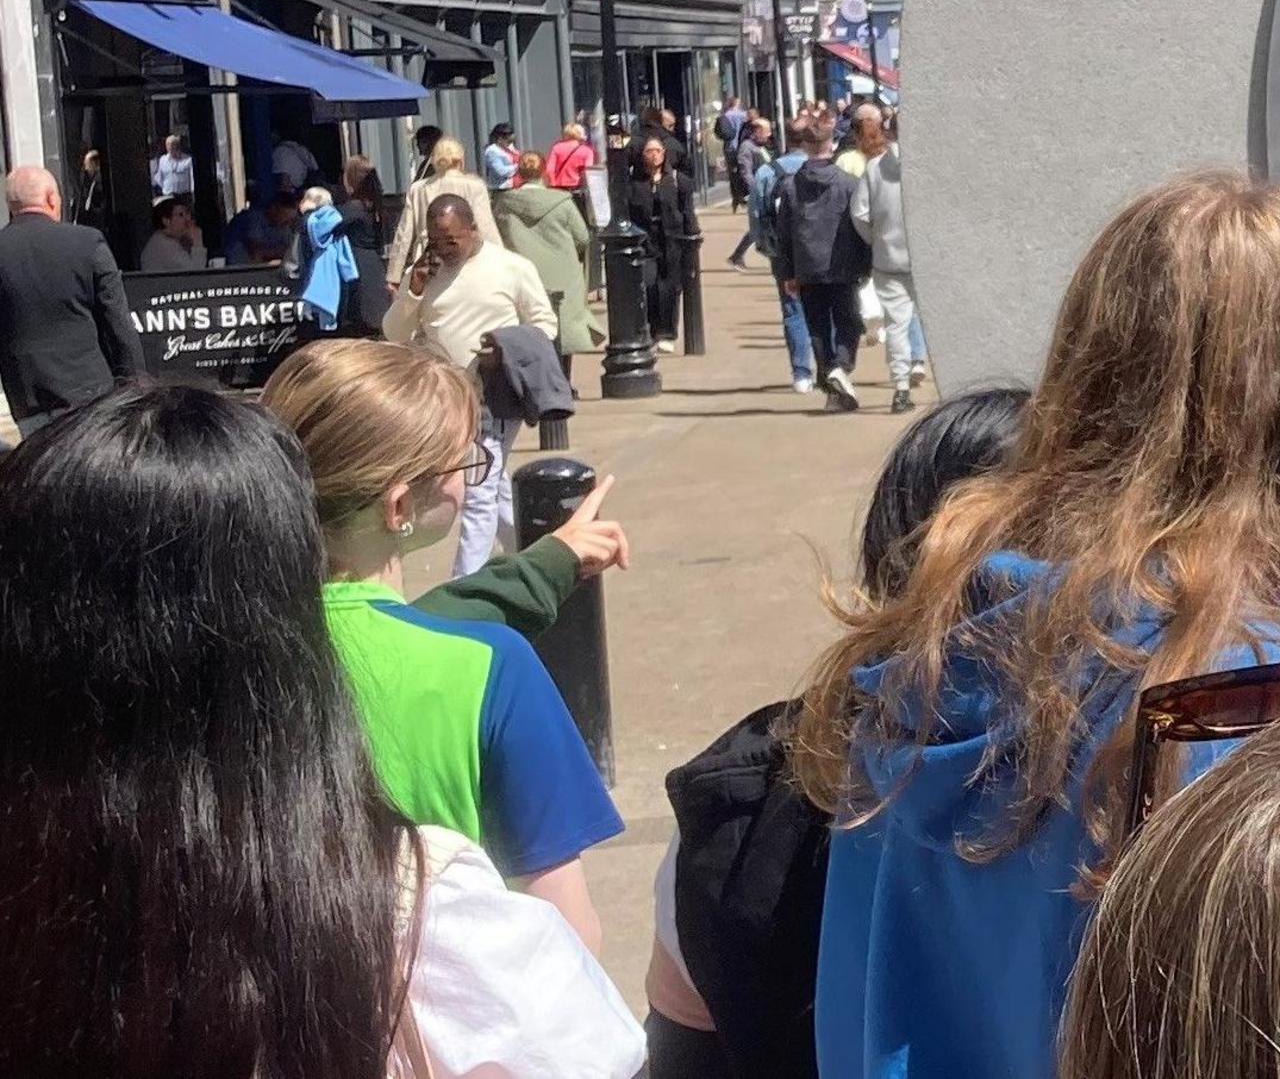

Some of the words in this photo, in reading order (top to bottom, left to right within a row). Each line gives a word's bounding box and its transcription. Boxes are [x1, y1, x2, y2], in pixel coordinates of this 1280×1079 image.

[220, 301, 314, 328] BAKER
[163, 334, 201, 361] Great
[204, 329, 240, 350] Cakes
